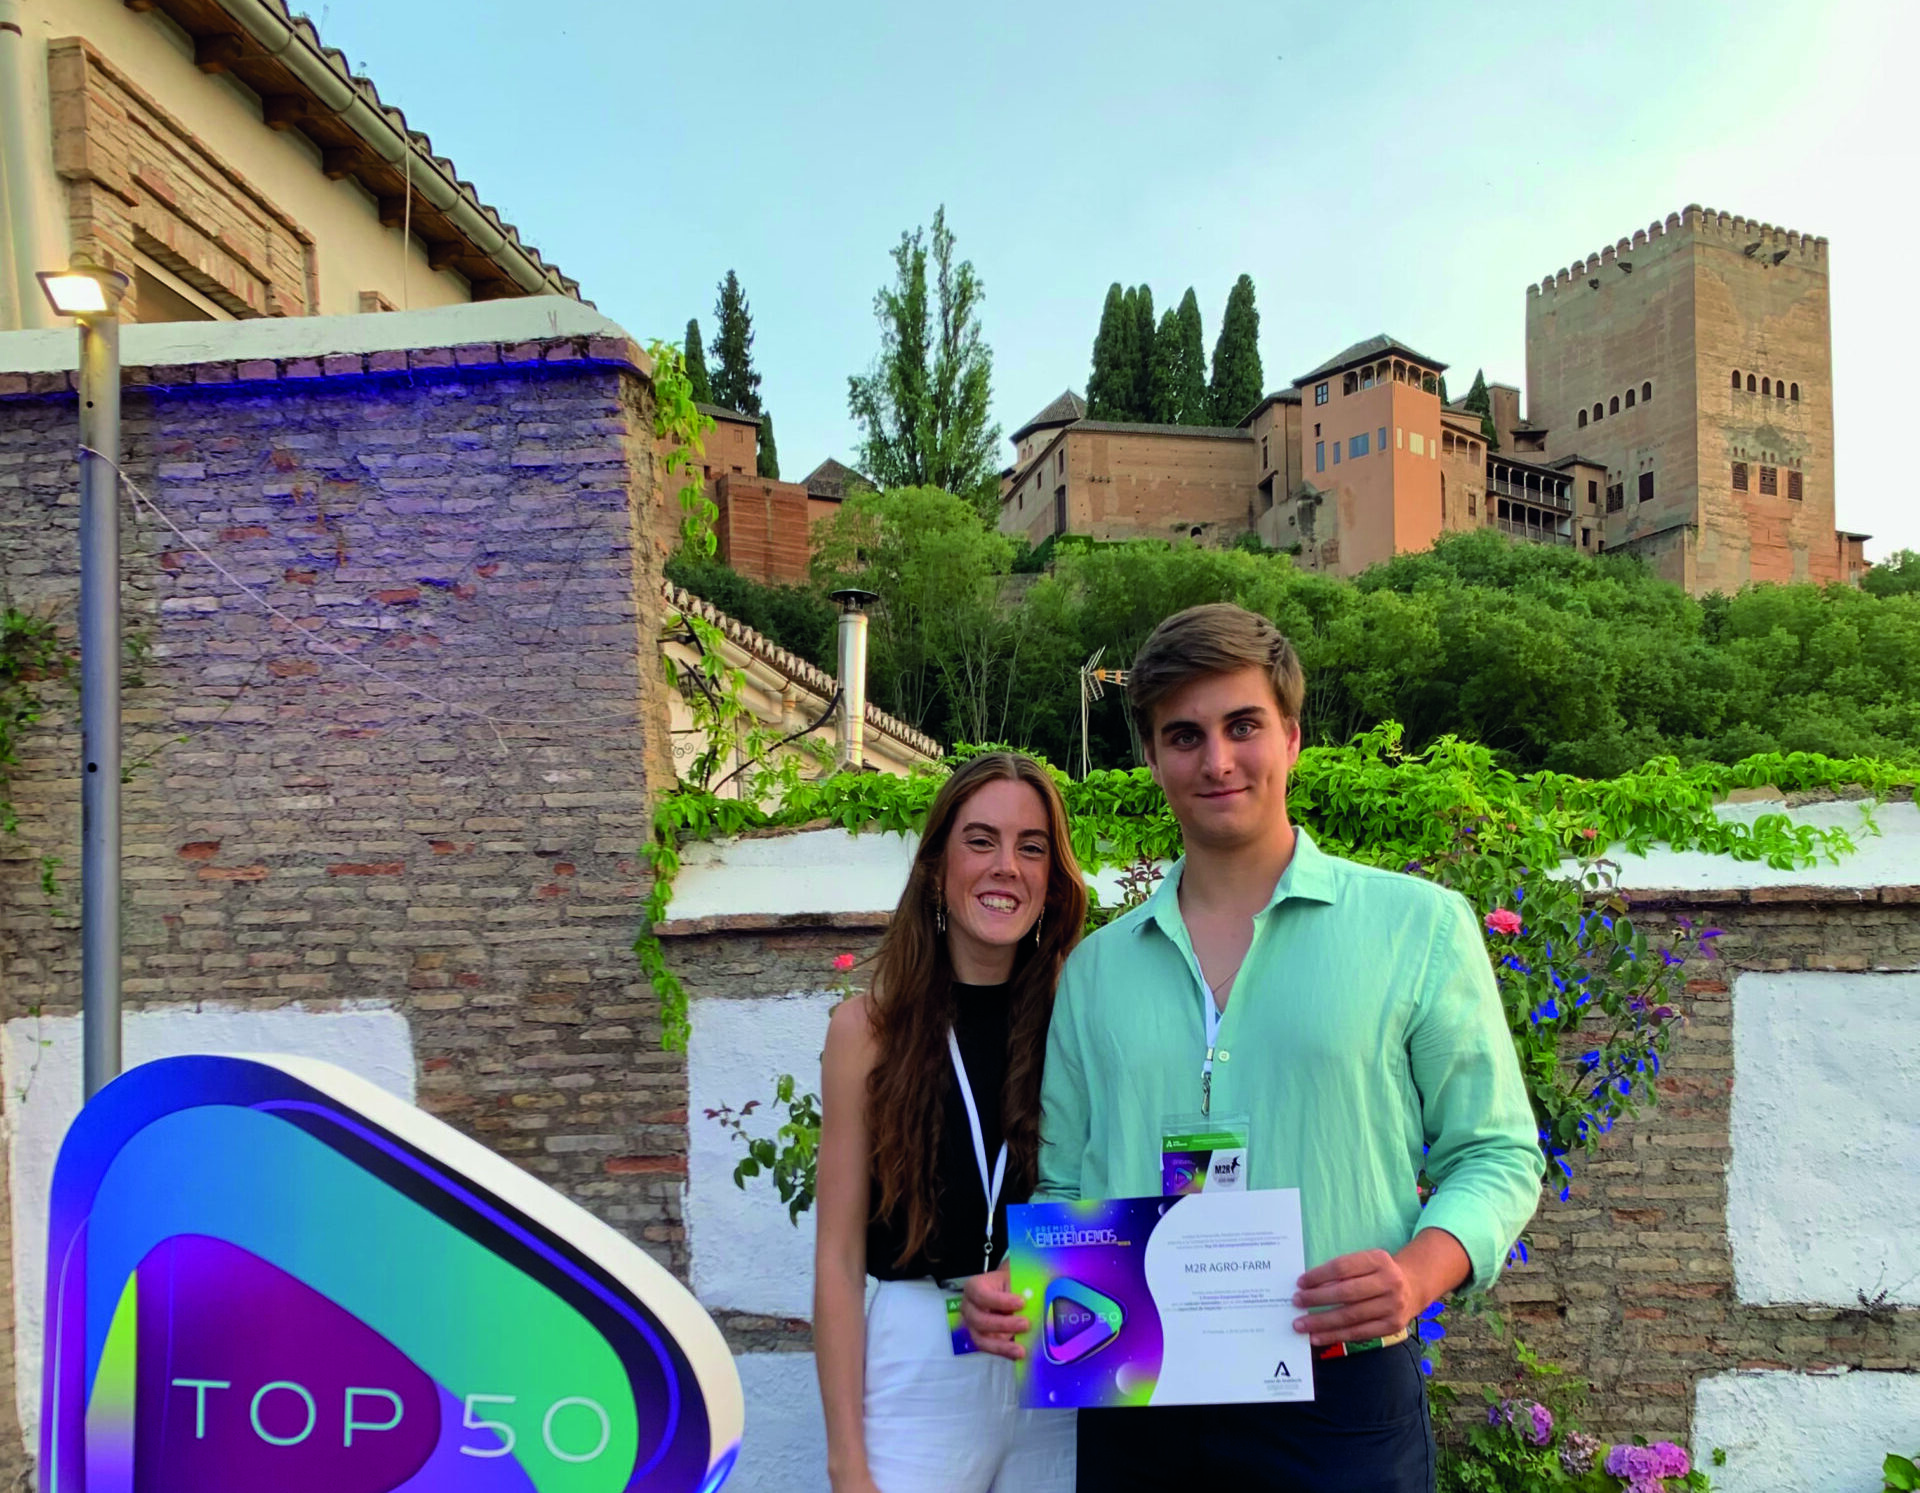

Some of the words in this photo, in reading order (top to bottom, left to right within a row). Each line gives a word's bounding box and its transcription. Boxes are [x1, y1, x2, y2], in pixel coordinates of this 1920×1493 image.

[1214, 1164, 1231, 1175] M2R
[1184, 1262, 1207, 1274] M2R
[1208, 1260, 1272, 1273] AGRO-FARM
[1058, 1312, 1092, 1325] TOP
[1098, 1311, 1120, 1324] 50
[171, 1377, 404, 1447] TOP
[459, 1393, 612, 1463] 50
